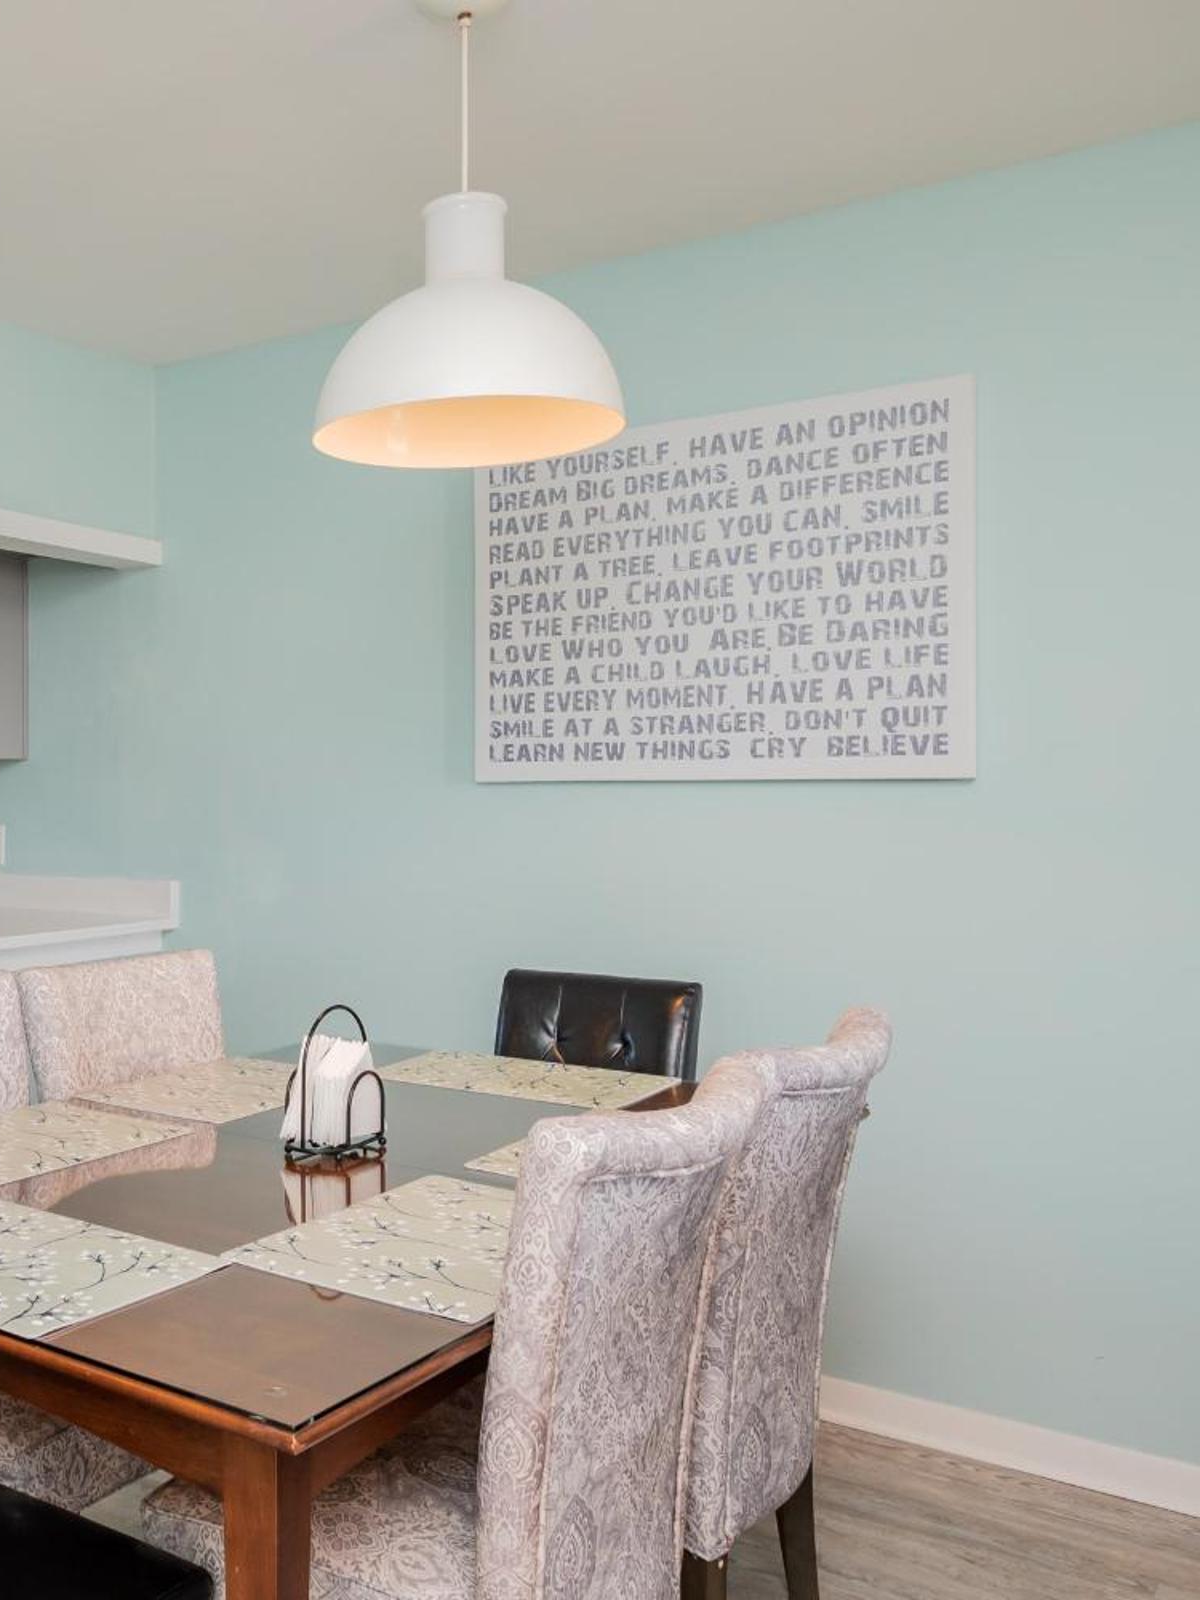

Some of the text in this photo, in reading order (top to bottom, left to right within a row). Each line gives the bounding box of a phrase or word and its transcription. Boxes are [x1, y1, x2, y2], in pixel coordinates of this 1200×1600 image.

[488, 462, 537, 488] LIKE
[689, 427, 763, 459] HAVE
[776, 419, 815, 447] AN
[827, 398, 949, 438] OPINION
[489, 486, 567, 513] DREAM
[576, 478, 615, 502] BIG
[747, 446, 839, 480] DANCE
[852, 431, 947, 464] OFTEN
[489, 512, 549, 536] HAVE
[558, 510, 573, 529] A
[667, 488, 739, 516] MAKE
[750, 484, 768, 505] A
[780, 460, 949, 502] DIFFERENCE
[489, 539, 545, 565] READ
[553, 520, 706, 557] EVERYTHING
[718, 512, 772, 539] YOU
[862, 491, 949, 523] SMILE
[489, 564, 563, 589] PLANT
[573, 560, 589, 582] A
[672, 543, 758, 571] LEAVE
[769, 523, 949, 562] FOOTPRINTS
[489, 590, 567, 617] SPEAK
[625, 574, 734, 605] CHANGE
[747, 566, 823, 595] YOUR
[836, 554, 948, 587] WORLD
[489, 585, 948, 640] BE THE FRIEND YOU'D LIKE TO HAVE
[489, 666, 554, 688] MAKE
[564, 665, 581, 685] A
[590, 660, 664, 684] CHILD
[792, 648, 871, 673] LOVE
[884, 643, 949, 668] LIFE
[490, 642, 552, 664] LOVE
[561, 638, 623, 661] WHO
[634, 633, 688, 656] YOU
[778, 623, 813, 647] BE
[826, 612, 948, 643] DARING
[489, 692, 536, 715] LIVE
[543, 689, 617, 713] EVERY
[747, 678, 823, 704] HAVE
[835, 677, 854, 702] A
[867, 673, 947, 700] PLAN
[489, 718, 554, 740] SMILE
[564, 718, 592, 738] AT
[603, 717, 620, 737] A
[785, 708, 867, 731] DON'T
[880, 705, 948, 732] QUIT
[489, 733, 949, 763] LEARN NEW THINGS CRY BELIEVE
